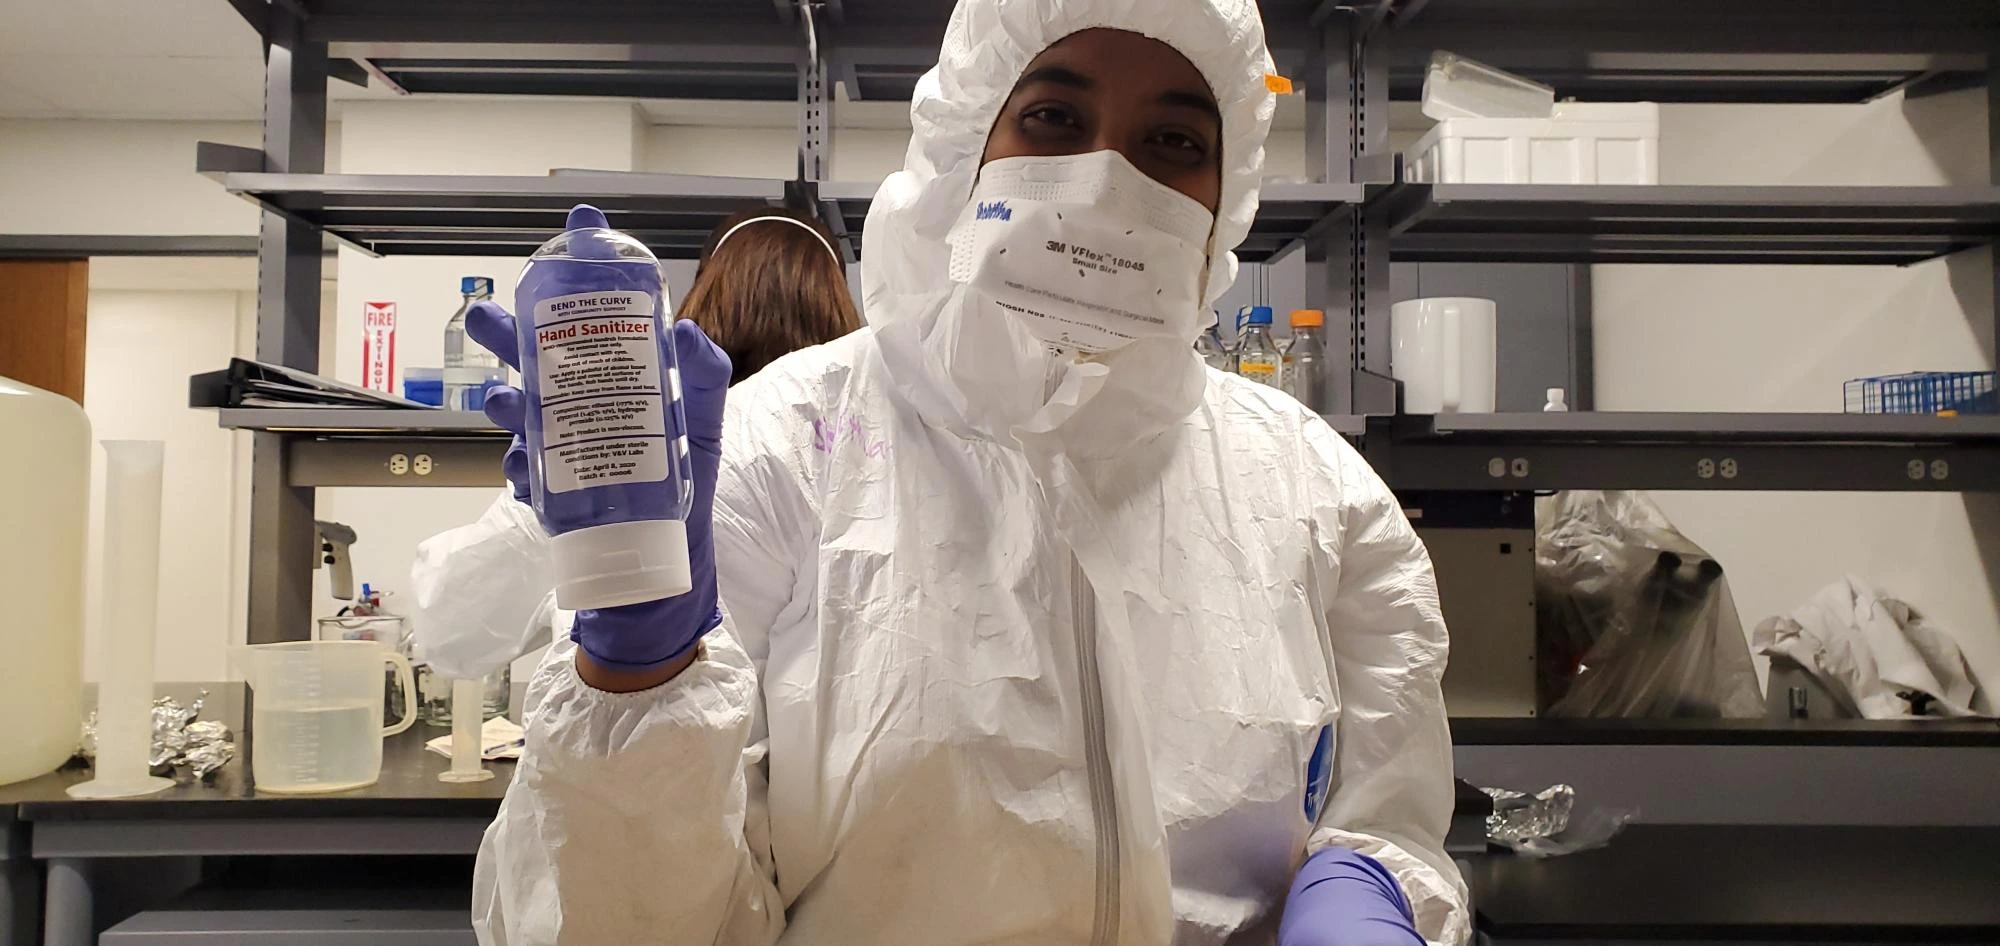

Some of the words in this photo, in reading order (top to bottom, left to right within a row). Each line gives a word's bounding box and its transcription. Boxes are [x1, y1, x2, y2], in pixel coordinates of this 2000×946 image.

[1046, 239, 1066, 253] 3M
[1072, 257, 1097, 270] Small
[1099, 264, 1118, 274] Size
[551, 301, 576, 312] BEND
[579, 298, 597, 307] THE
[600, 297, 632, 305] CURVE
[571, 307, 602, 315] COMMUNITY
[367, 312, 393, 326] FIRE
[539, 325, 577, 343] Hand
[581, 320, 649, 336] Sanitizer
[374, 330, 383, 391] EXTINGUI
[581, 366, 602, 374] palmful
[555, 376, 576, 384] handrub
[552, 404, 590, 415] Composition:
[592, 401, 615, 409] ethanol
[557, 412, 579, 422] glycerol
[618, 406, 647, 414] hydrogen
[569, 417, 594, 426] peroxide
[577, 428, 600, 436] Product
[560, 445, 604, 456] Manufactured
[606, 442, 626, 450] under
[565, 453, 599, 463] conditions
[600, 451, 611, 459] by:
[574, 466, 592, 474] Date:
[593, 462, 610, 471] April
[579, 472, 598, 480] Batch
